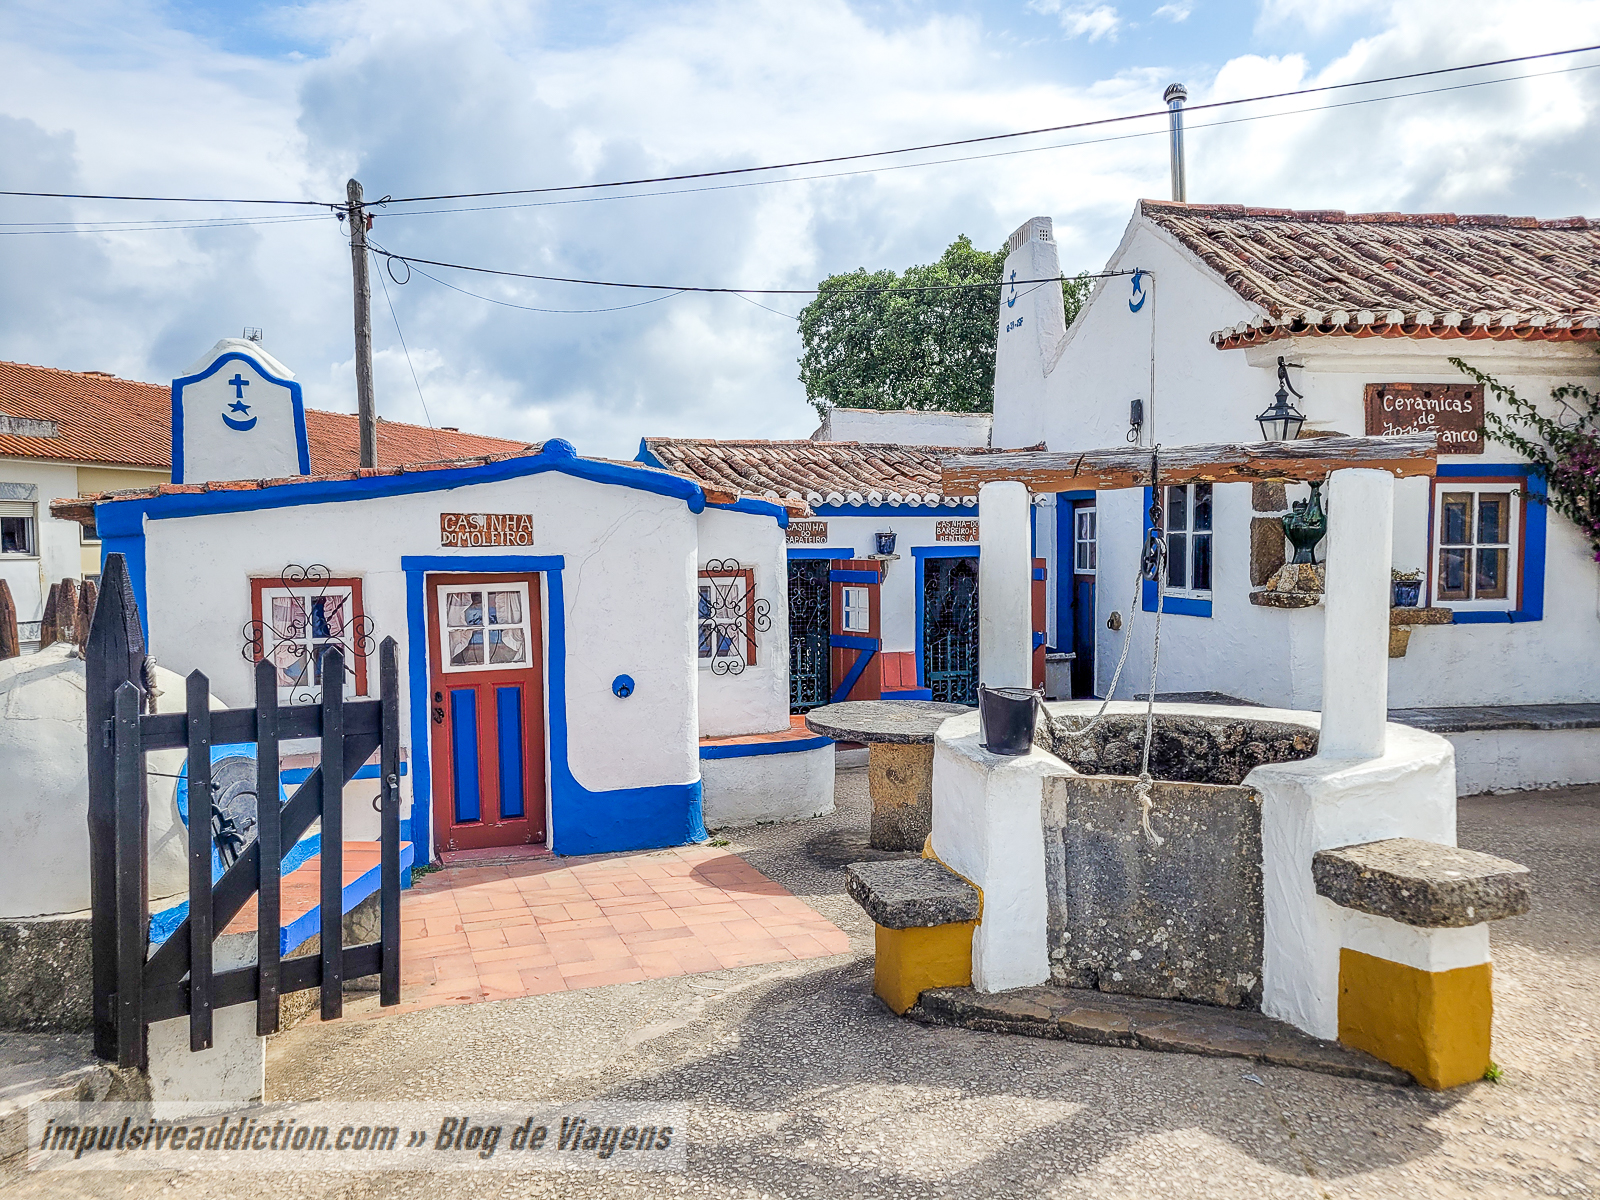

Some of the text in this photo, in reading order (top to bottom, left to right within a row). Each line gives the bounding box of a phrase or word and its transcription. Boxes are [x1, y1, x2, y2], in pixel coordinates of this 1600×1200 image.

[1418, 411, 1436, 424] de
[444, 515, 533, 532] CASINHA
[786, 522, 825, 532] CASINHA
[457, 531, 528, 547] MOLEIRO
[785, 535, 827, 544] SAPATEIRO
